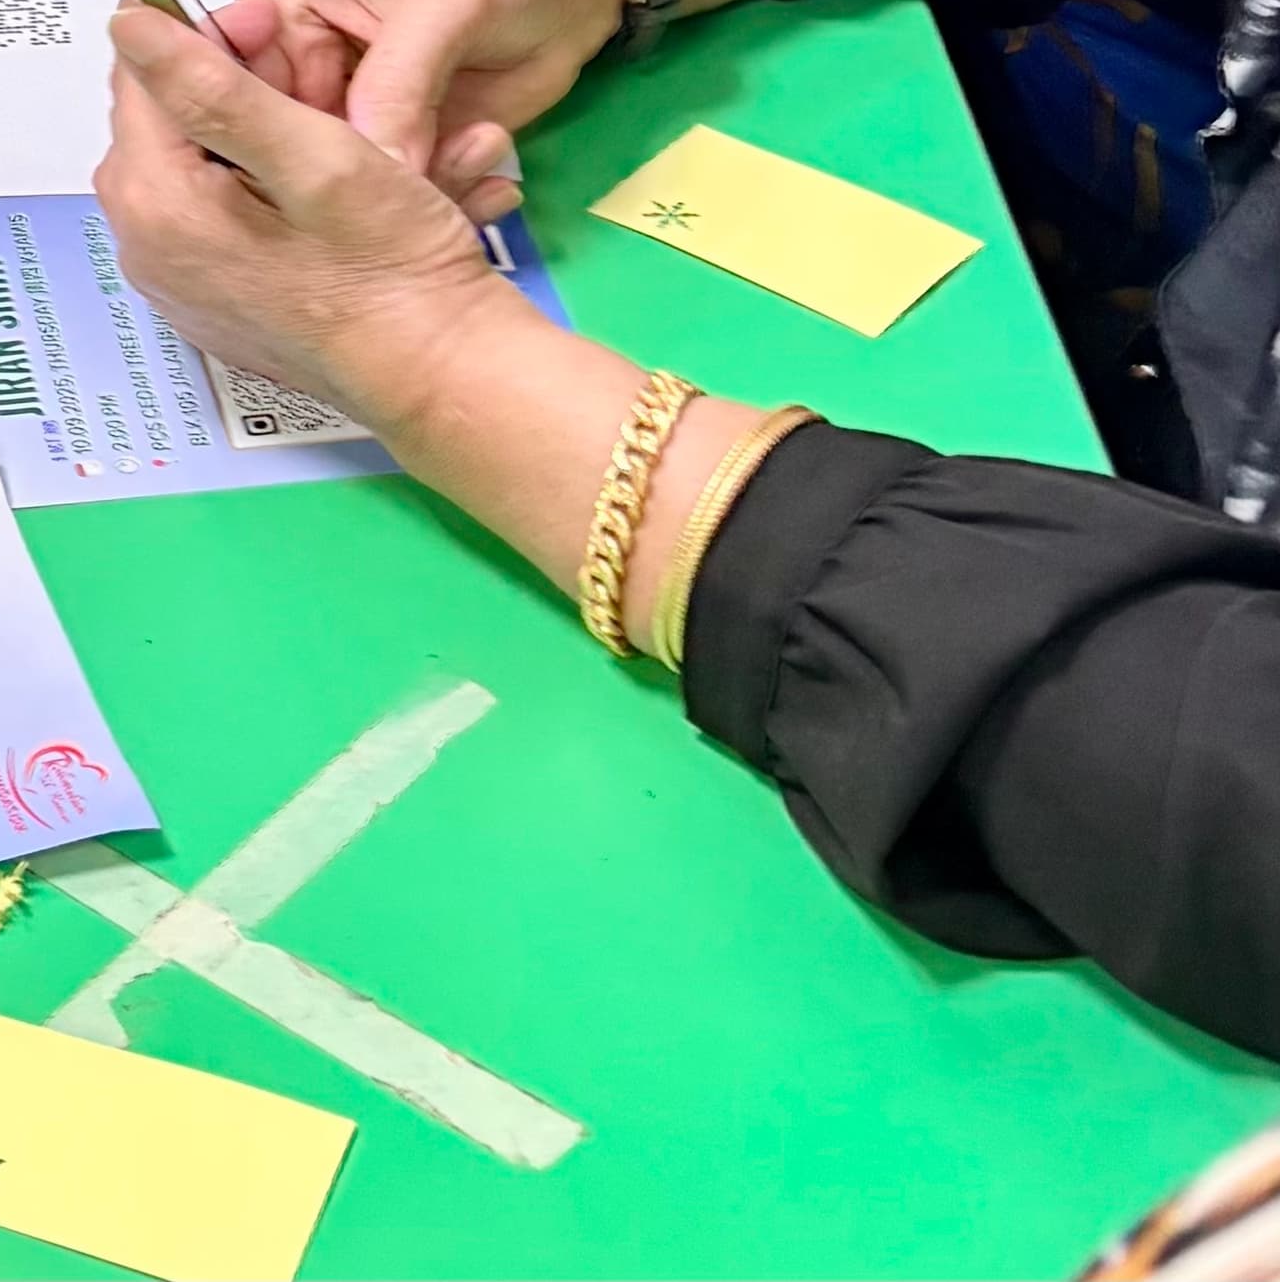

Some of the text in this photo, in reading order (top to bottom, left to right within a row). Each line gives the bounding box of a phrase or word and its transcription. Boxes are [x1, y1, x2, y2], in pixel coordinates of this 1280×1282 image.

[10, 215, 40, 263] KHAMIS
[34, 298, 71, 371] THURSDAY
[117, 334, 143, 366] TREE
[161, 345, 193, 386] JALAN
[132, 372, 162, 417] CEDAR
[145, 423, 171, 450] PCS
